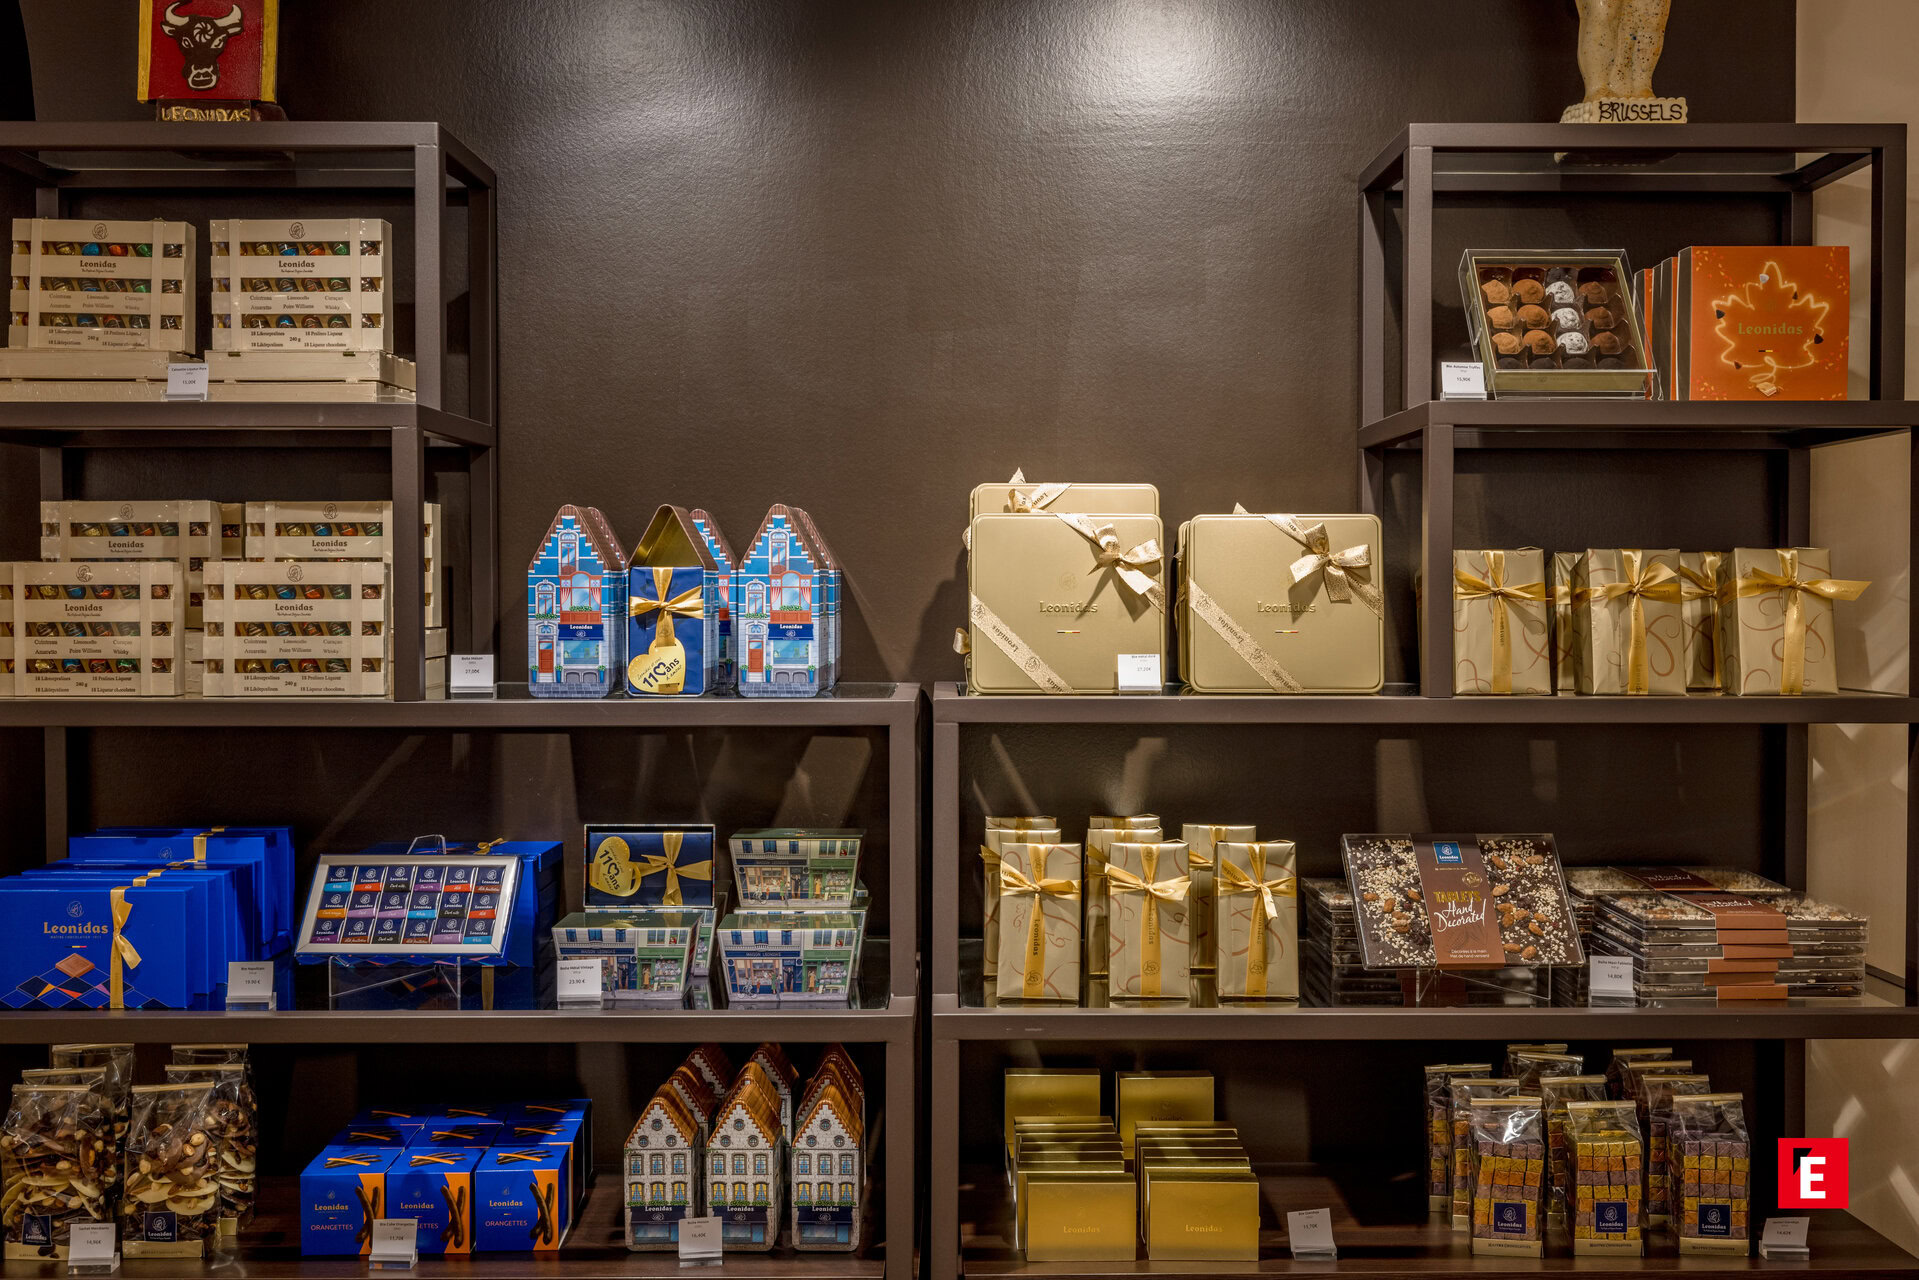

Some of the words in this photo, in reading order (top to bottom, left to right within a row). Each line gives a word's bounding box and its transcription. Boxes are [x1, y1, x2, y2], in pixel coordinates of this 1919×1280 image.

[161, 106, 250, 121] LEONIDAS
[1599, 102, 1682, 122] BRUSSELS
[80, 260, 116, 268] Leonidas
[278, 260, 315, 268] Leonidas
[1739, 322, 1803, 336] Leonidas
[64, 604, 103, 612] Leonidas
[1039, 601, 1099, 613] Leonidas
[1257, 601, 1317, 613] Leonidas
[1218, 616, 1245, 645] Leonidas
[992, 624, 1019, 653] Leonidas
[1433, 890, 1482, 903] TABLETS
[1442, 897, 1474, 918] Hand
[1434, 899, 1487, 932] Decorated
[43, 921, 109, 934] Leonidas
[1032, 919, 1041, 956] Leonidas
[1063, 1225, 1101, 1233] Leonidas
[1185, 1224, 1224, 1232] Leonidas
